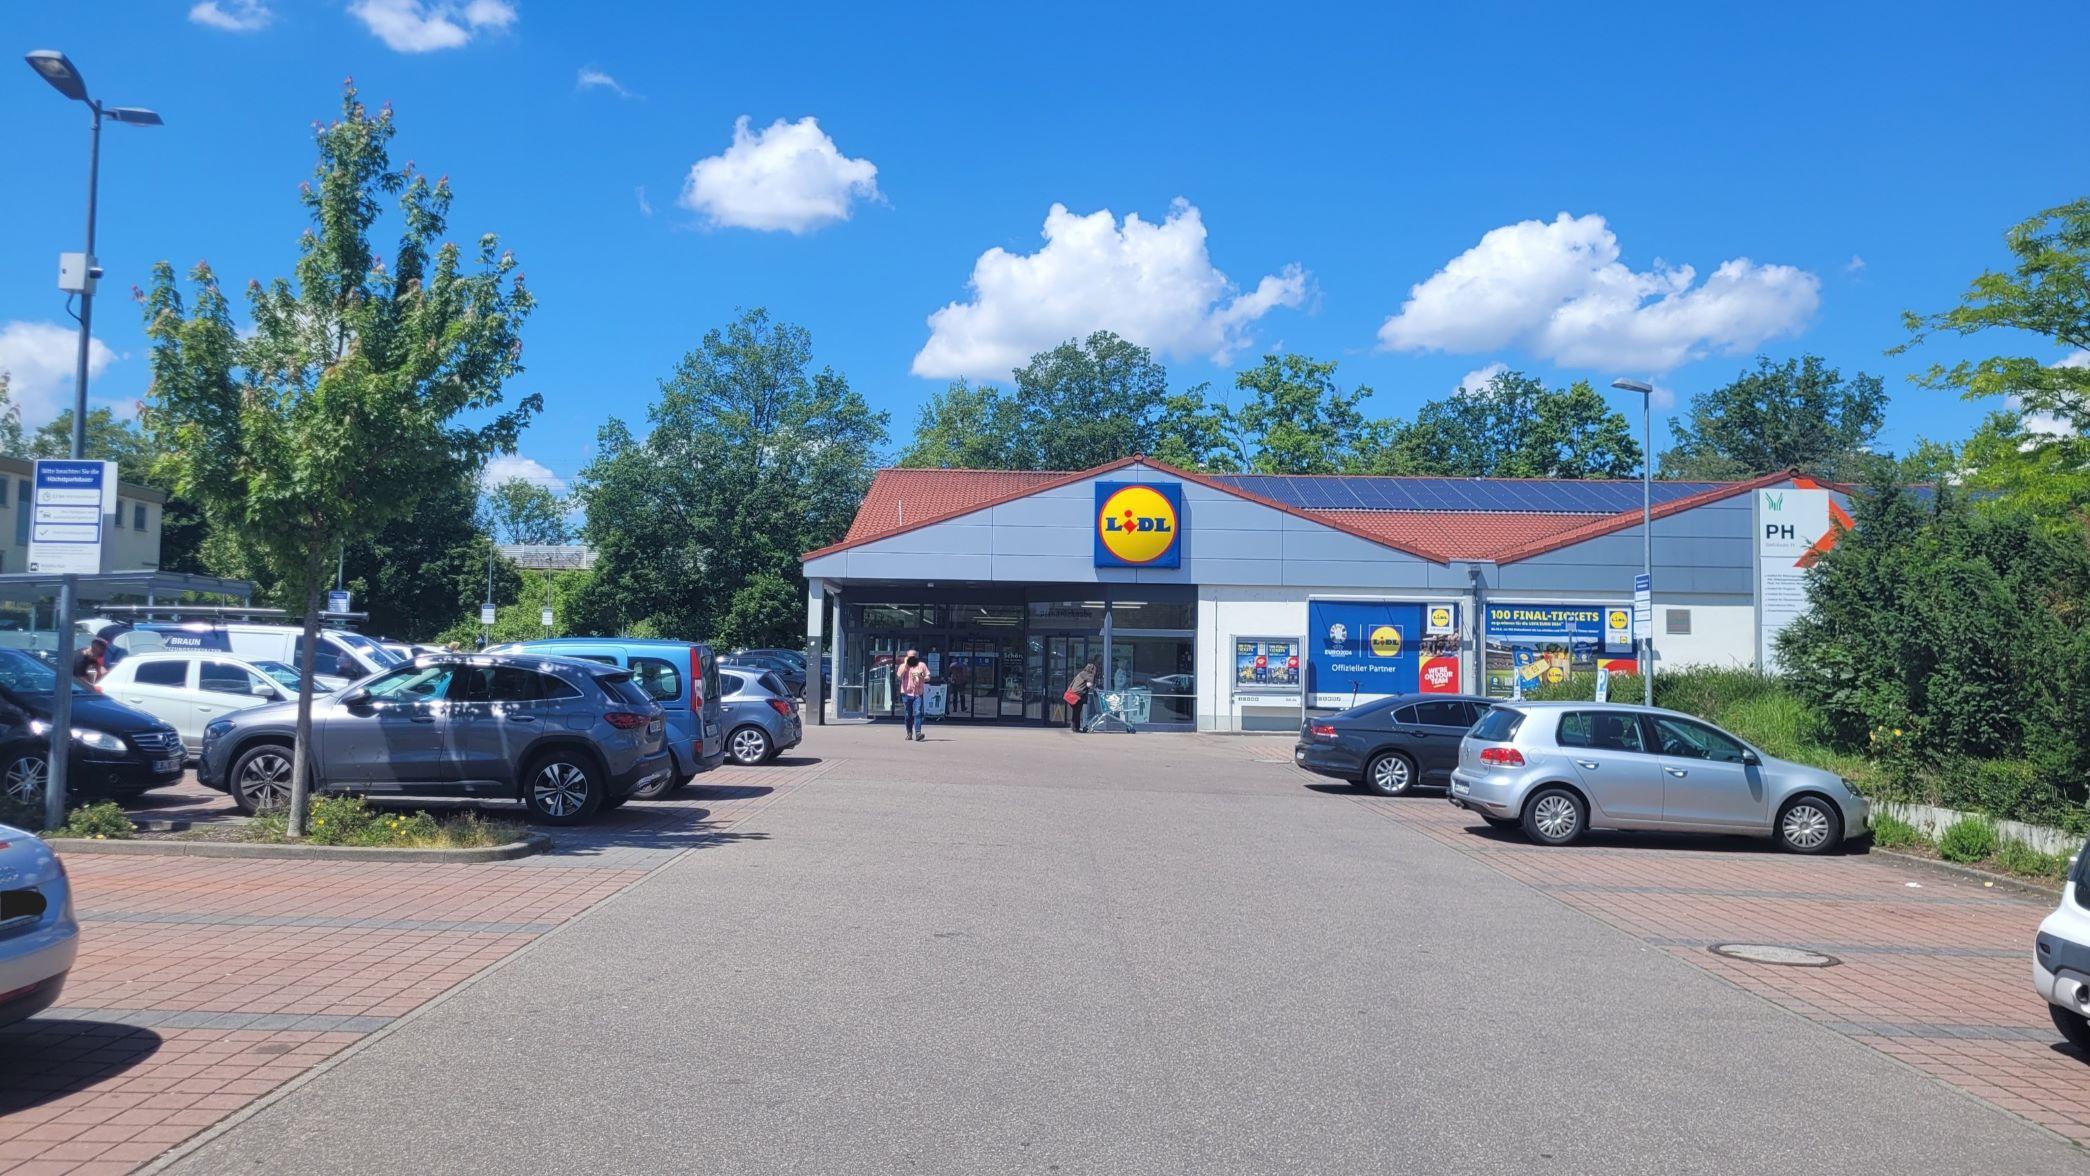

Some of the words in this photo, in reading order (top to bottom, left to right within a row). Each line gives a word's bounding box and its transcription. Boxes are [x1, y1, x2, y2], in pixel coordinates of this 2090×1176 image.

[1766, 524, 1794, 539] PH
[1491, 609, 1511, 620] 100
[1513, 610, 1599, 622] FINAL-TICKETS
[171, 637, 201, 646] BRAUN
[1331, 664, 1367, 672] Offizieller
[1369, 664, 1396, 672] Partner
